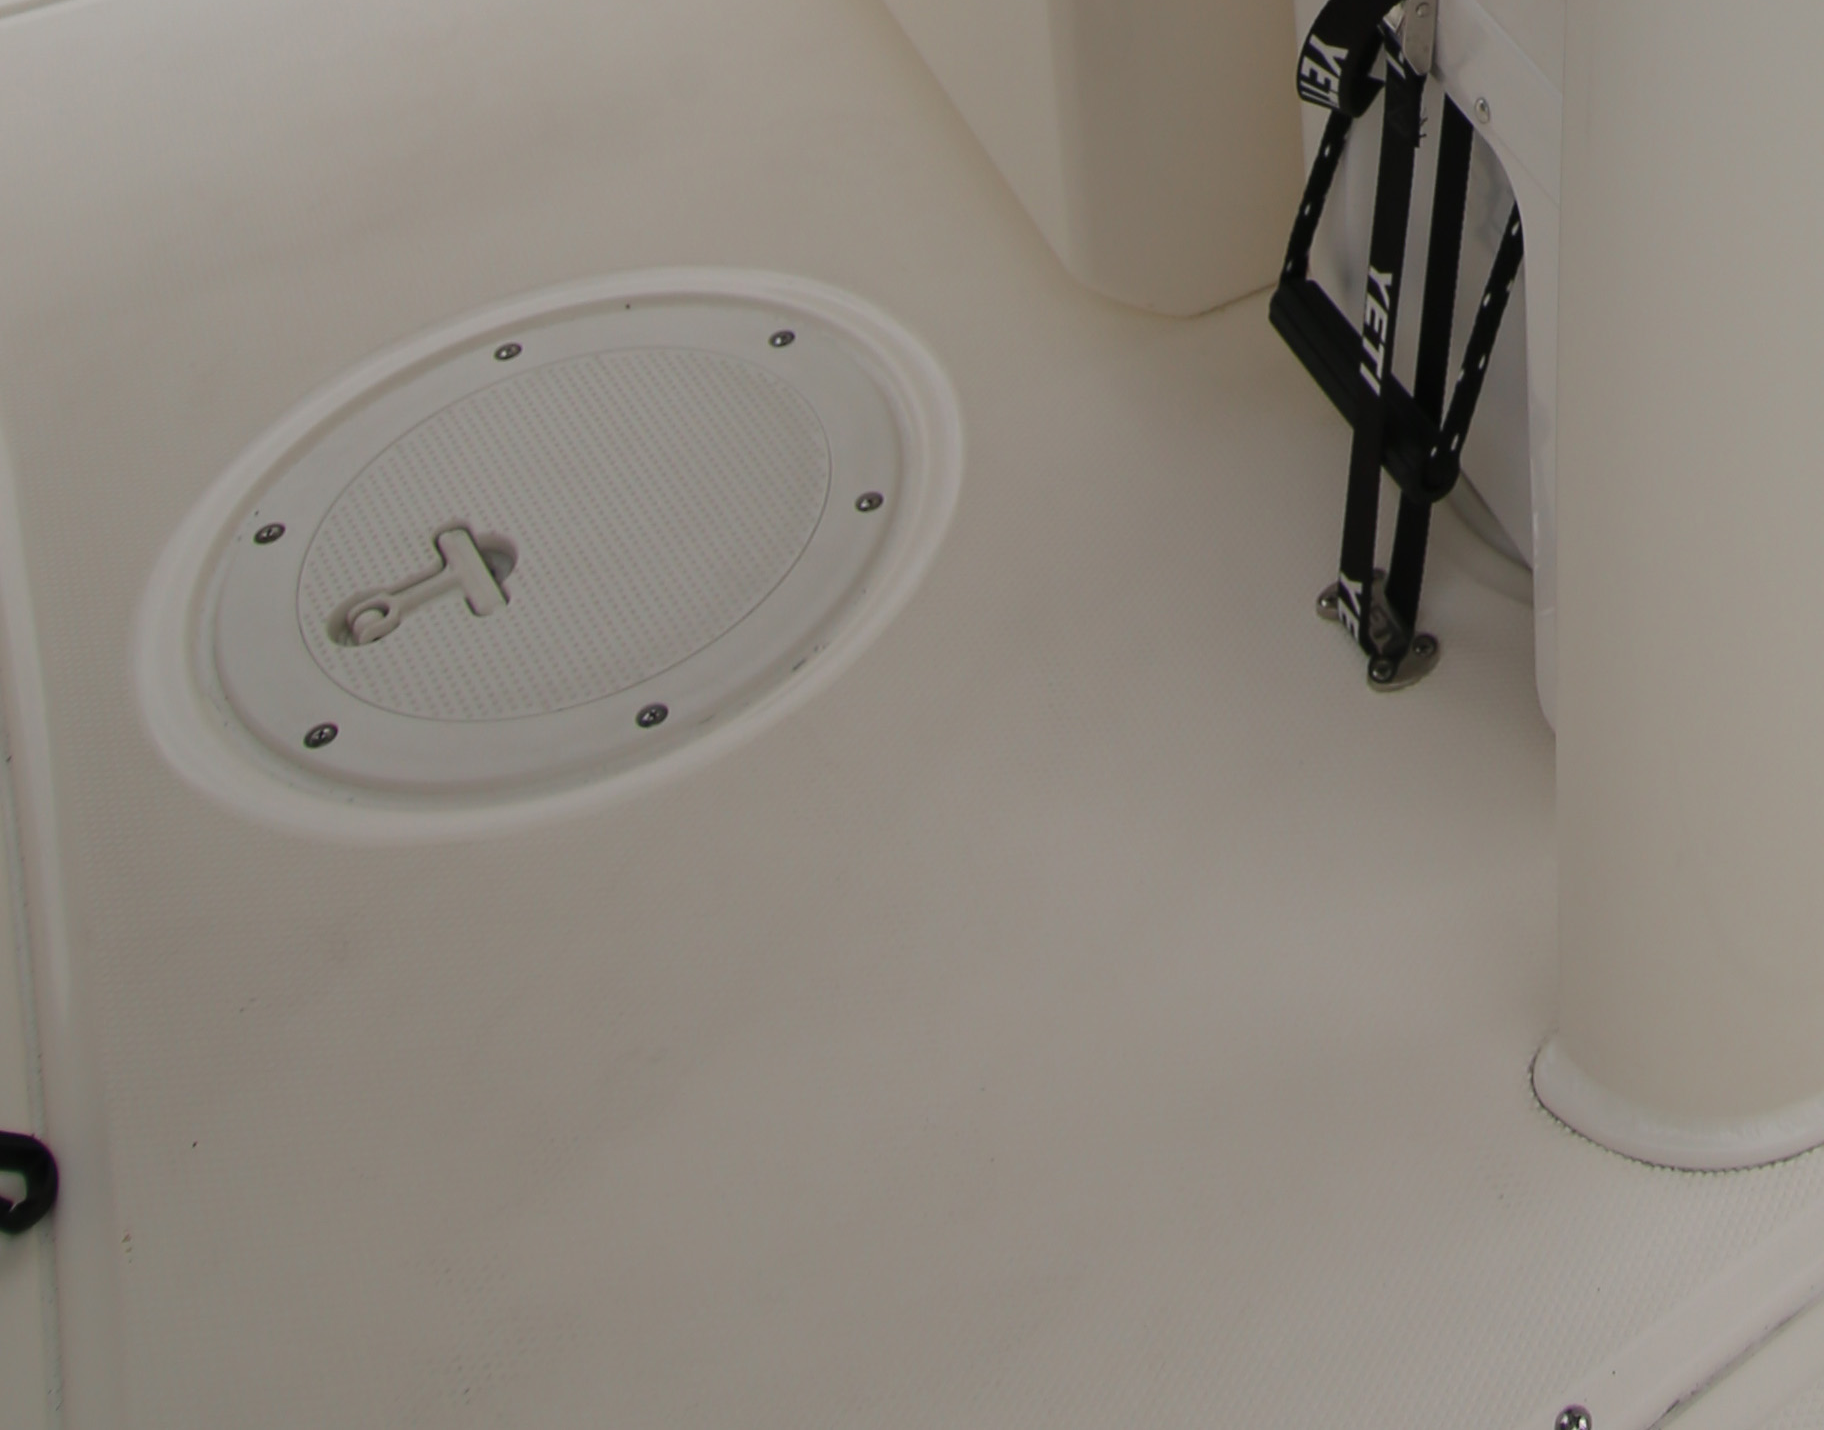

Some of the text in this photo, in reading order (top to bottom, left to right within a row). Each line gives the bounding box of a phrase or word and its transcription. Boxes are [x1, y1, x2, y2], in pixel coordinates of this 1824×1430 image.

[1300, 34, 1350, 109] YETI
[1360, 265, 1393, 397] YETI
[1338, 571, 1363, 642] YE
